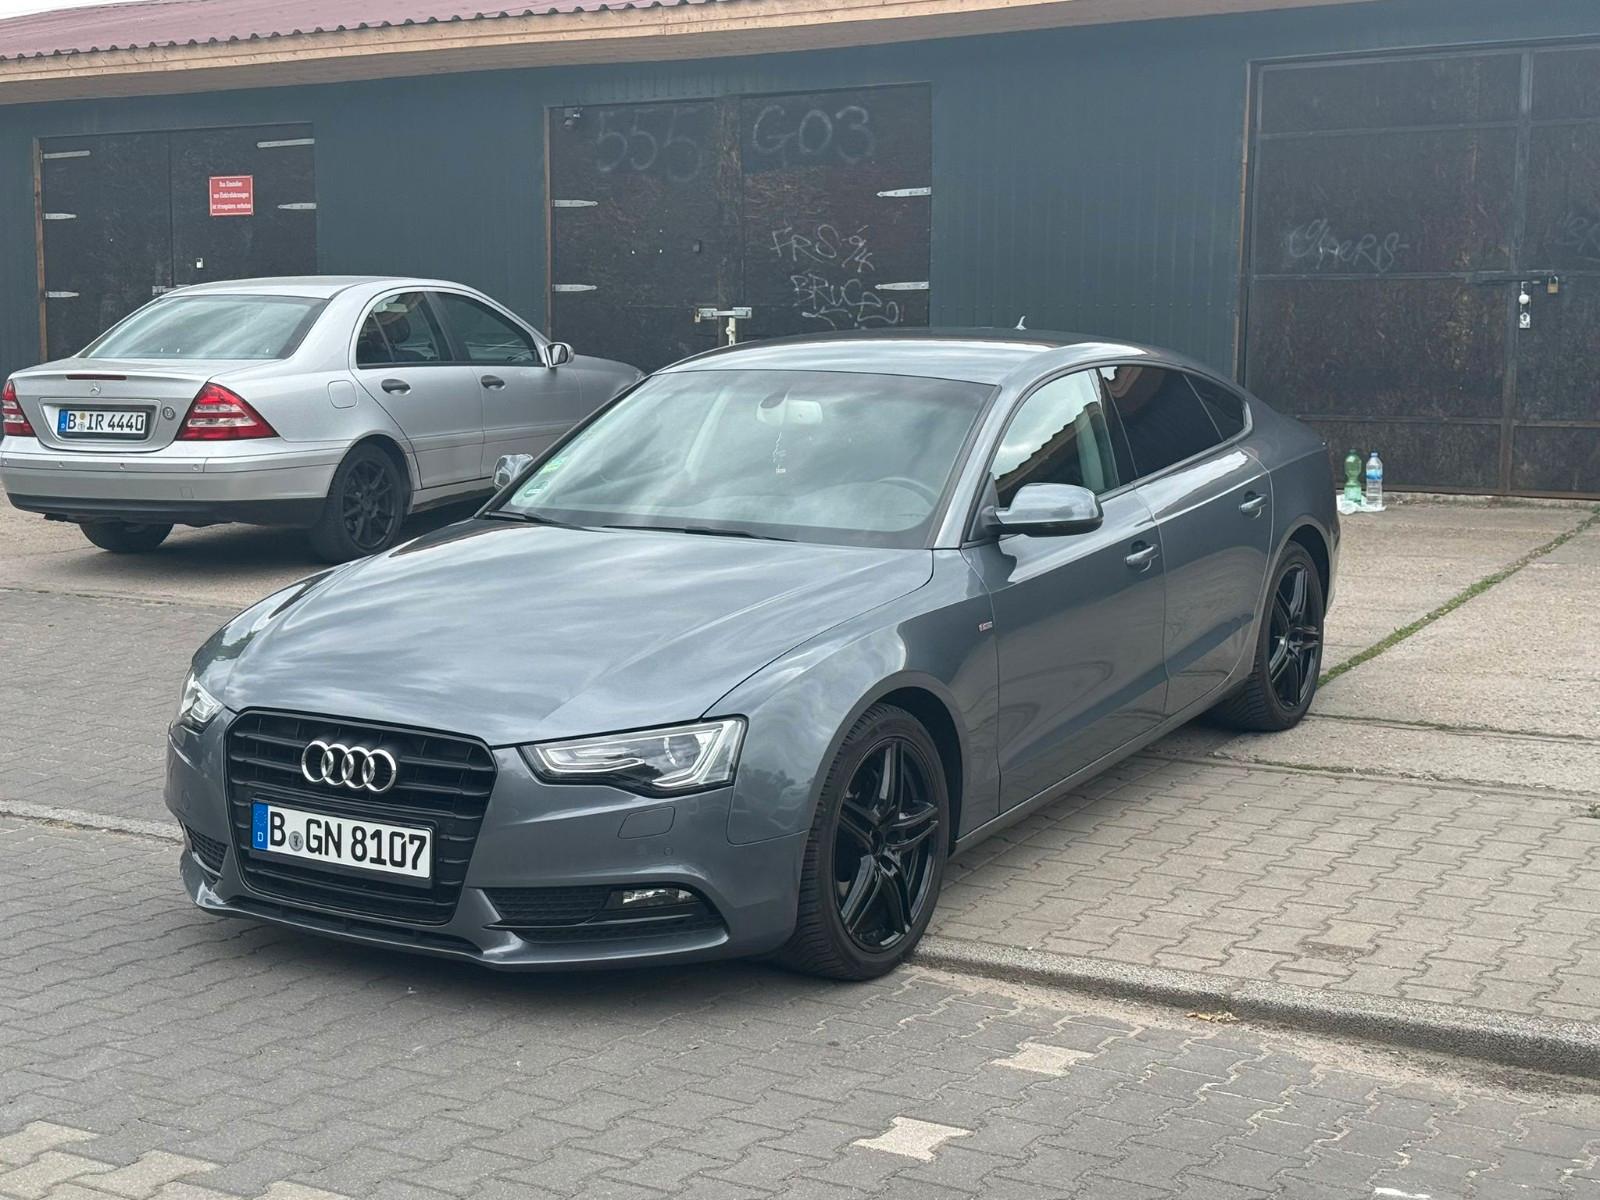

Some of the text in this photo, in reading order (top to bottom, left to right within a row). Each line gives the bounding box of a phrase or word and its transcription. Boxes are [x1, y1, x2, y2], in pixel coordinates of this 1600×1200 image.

[67, 413, 145, 432] B IR 4440
[269, 810, 428, 871] B GN 8107
